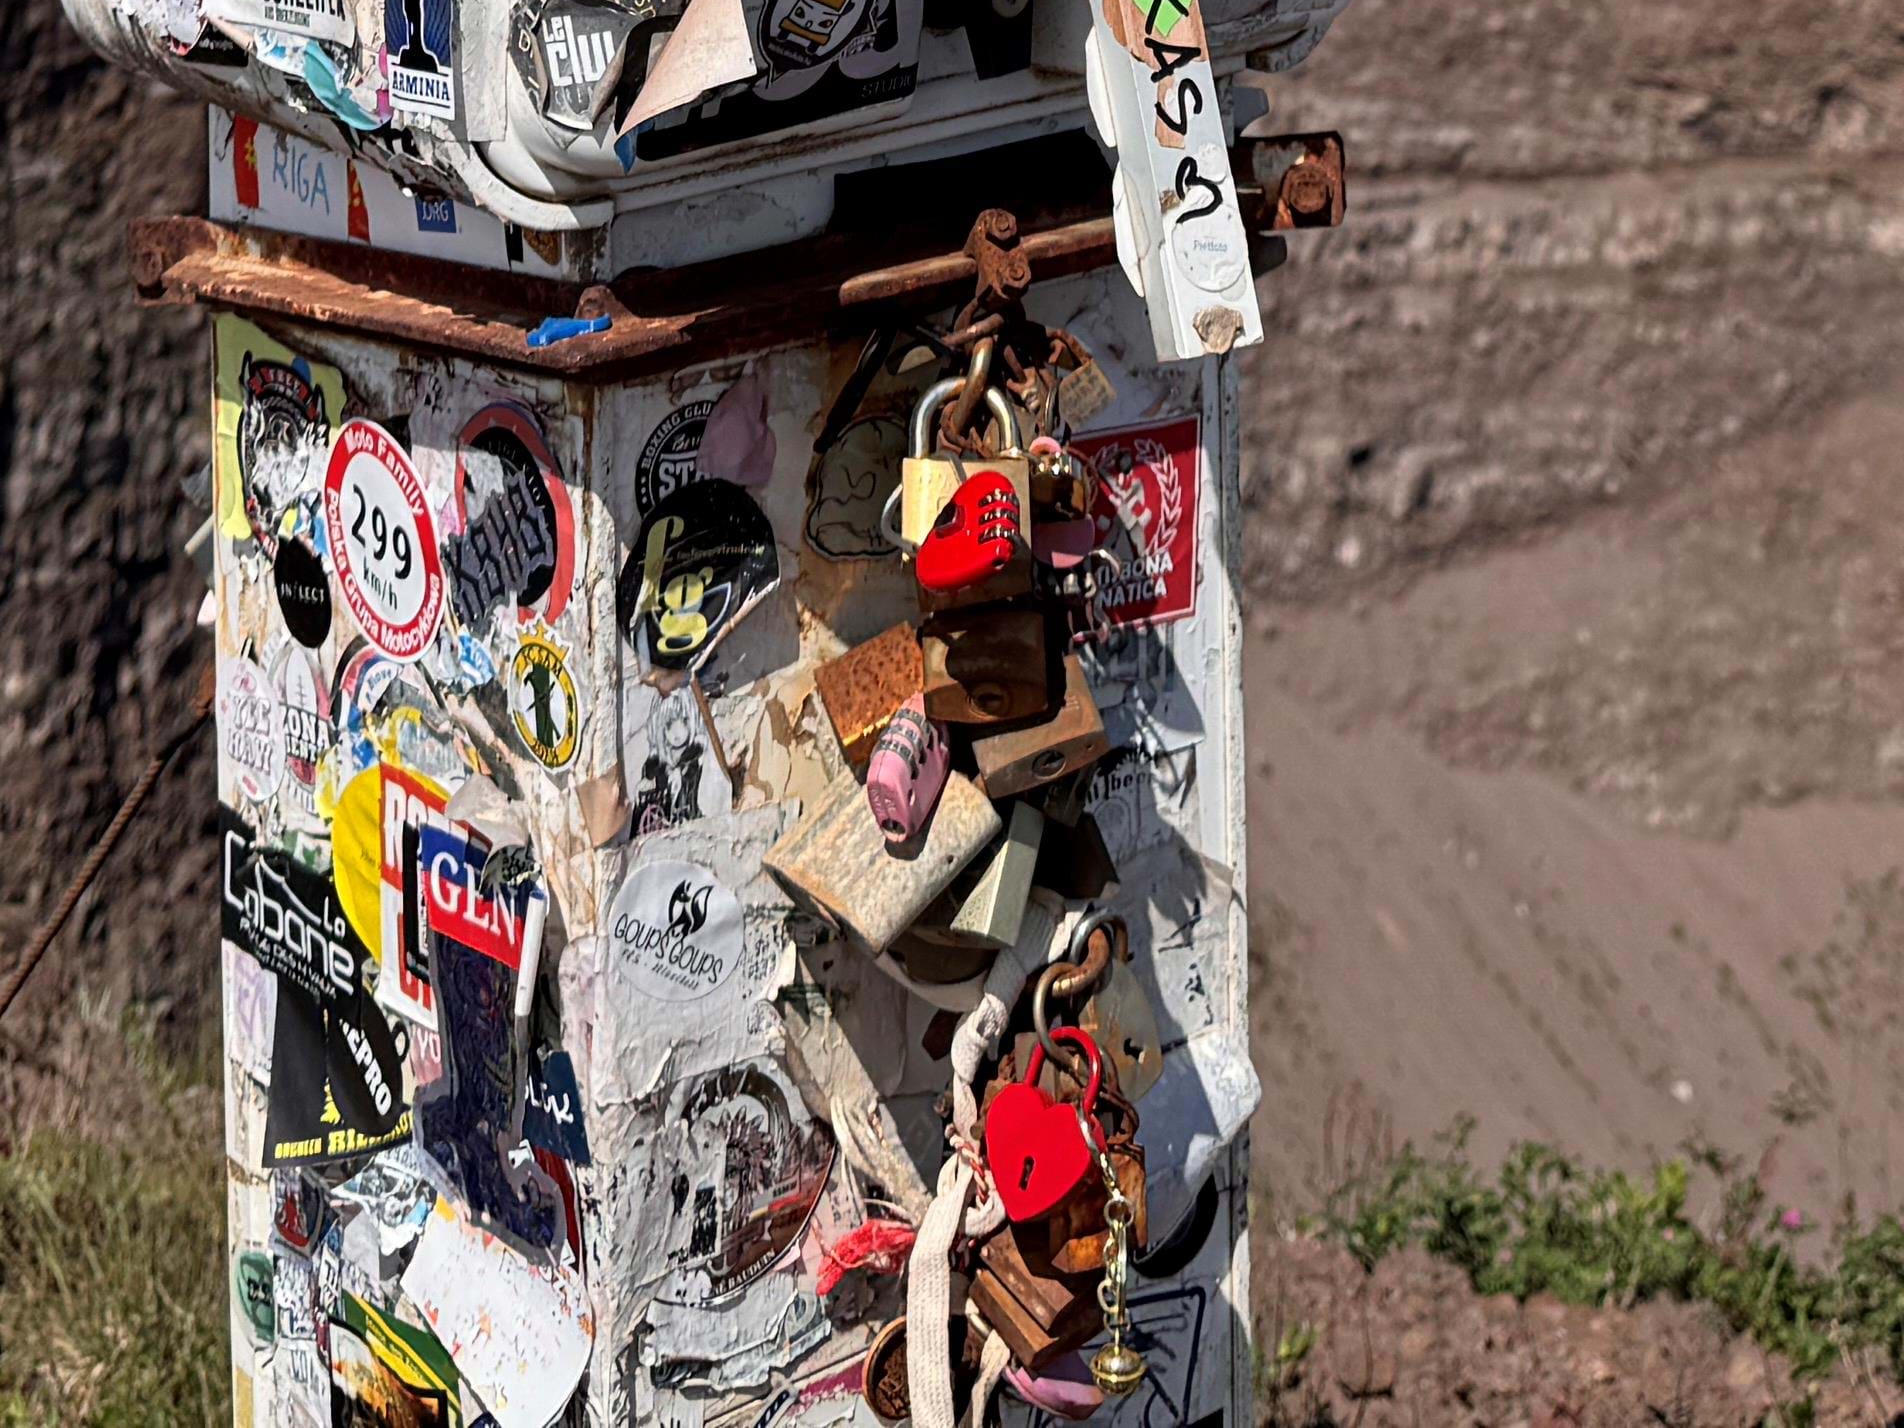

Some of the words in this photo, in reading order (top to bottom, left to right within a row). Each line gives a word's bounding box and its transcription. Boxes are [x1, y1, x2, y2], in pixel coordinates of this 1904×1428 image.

[392, 70, 451, 101] ARMINIA
[273, 143, 331, 216] RIGA
[377, 435, 424, 517] Family
[326, 486, 346, 570] Polska
[344, 575, 379, 639] Grupa
[350, 483, 412, 580] 299
[361, 557, 398, 611] km/h
